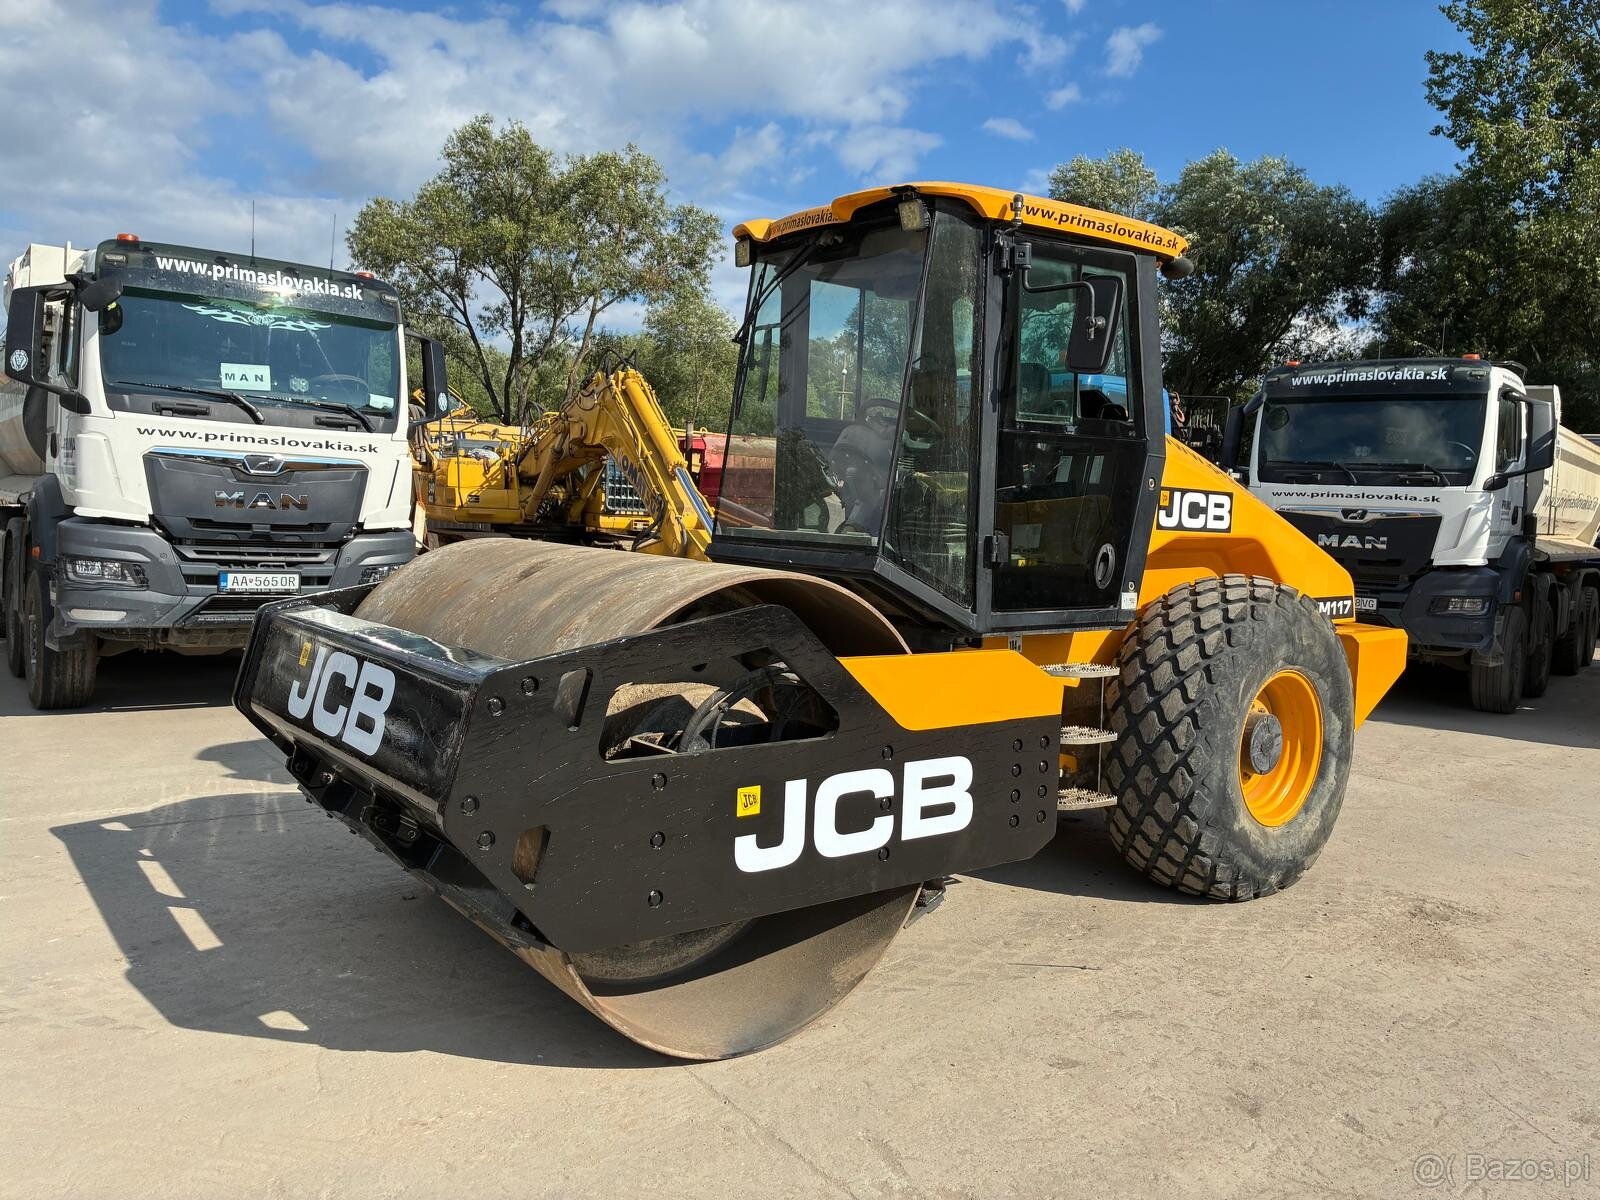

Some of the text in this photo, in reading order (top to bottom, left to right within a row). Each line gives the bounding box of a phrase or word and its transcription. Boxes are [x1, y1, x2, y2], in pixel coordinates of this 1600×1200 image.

[1010, 202, 1179, 250] ww.primaslovakia.sk
[155, 256, 364, 301] www.primaslovakia.sk
[224, 372, 265, 383] MAN
[136, 427, 378, 454] www.primaslovakia.sk
[214, 490, 309, 512] MAN
[1271, 491, 1441, 503] www.primaslovakia.sk
[1158, 491, 1231, 530] JCB
[1317, 533, 1388, 550] MAN
[1318, 600, 1352, 615] M117
[287, 645, 396, 757] JCB
[743, 794, 757, 808] JCB
[734, 755, 973, 873] JCB
